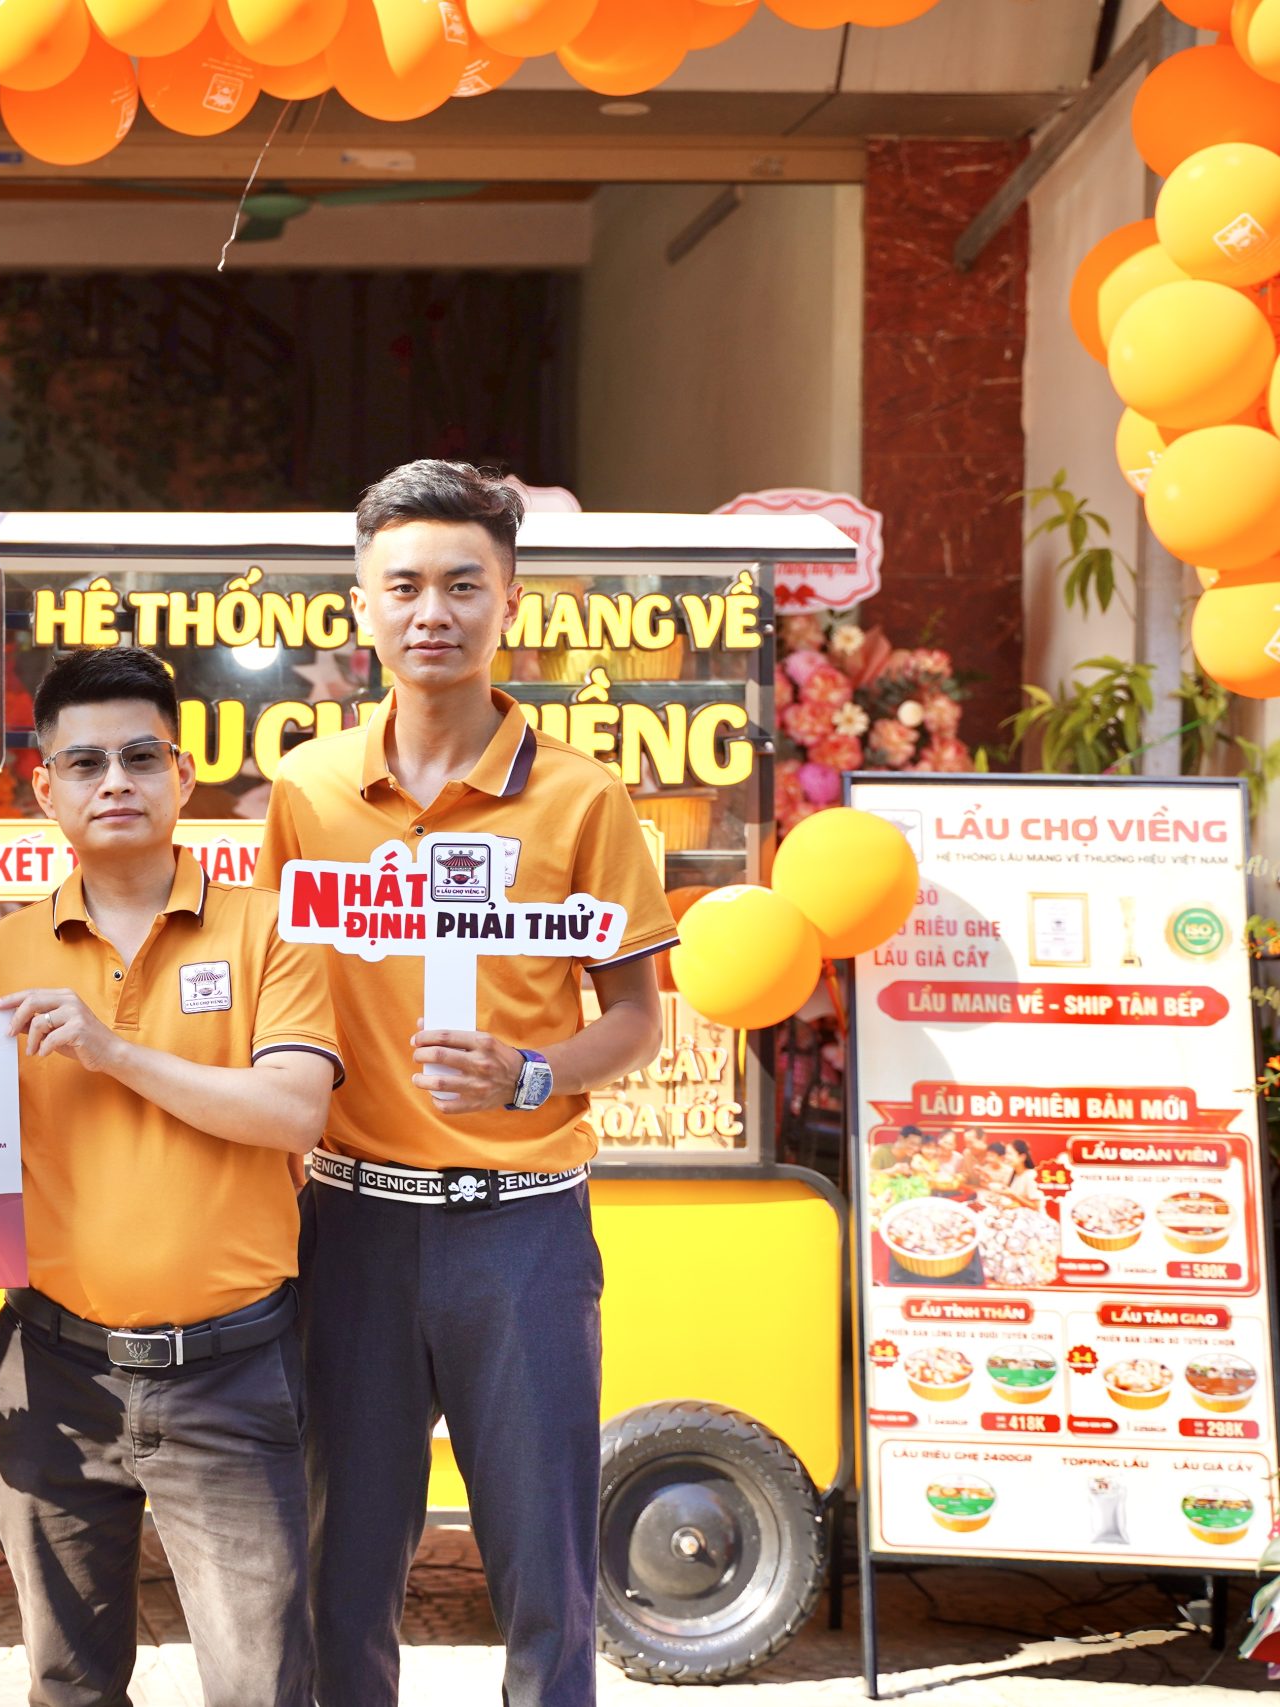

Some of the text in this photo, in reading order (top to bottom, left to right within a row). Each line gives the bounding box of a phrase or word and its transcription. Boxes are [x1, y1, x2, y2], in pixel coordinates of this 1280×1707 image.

[128, 567, 349, 649] THỐNG
[681, 570, 762, 649] VỀ
[935, 803, 1228, 847] LẨU CHỢ VIỀNG
[343, 911, 427, 946] ĐỊNH
[436, 901, 515, 940] PHẢI
[914, 915, 959, 936] RIÊU
[964, 920, 1001, 941] GHẸ
[907, 984, 946, 1013] LẨU
[952, 992, 1012, 1014] MANG
[1063, 994, 1114, 1016] SHIP
[1116, 991, 1159, 1020] TẬN
[1163, 990, 1205, 1017] BẾP
[920, 1086, 1188, 1121] LẨU BÒ PHIÊN BẢN MỚI
[1008, 1415, 1046, 1432] 418K
[1206, 1420, 1245, 1437] 298K
